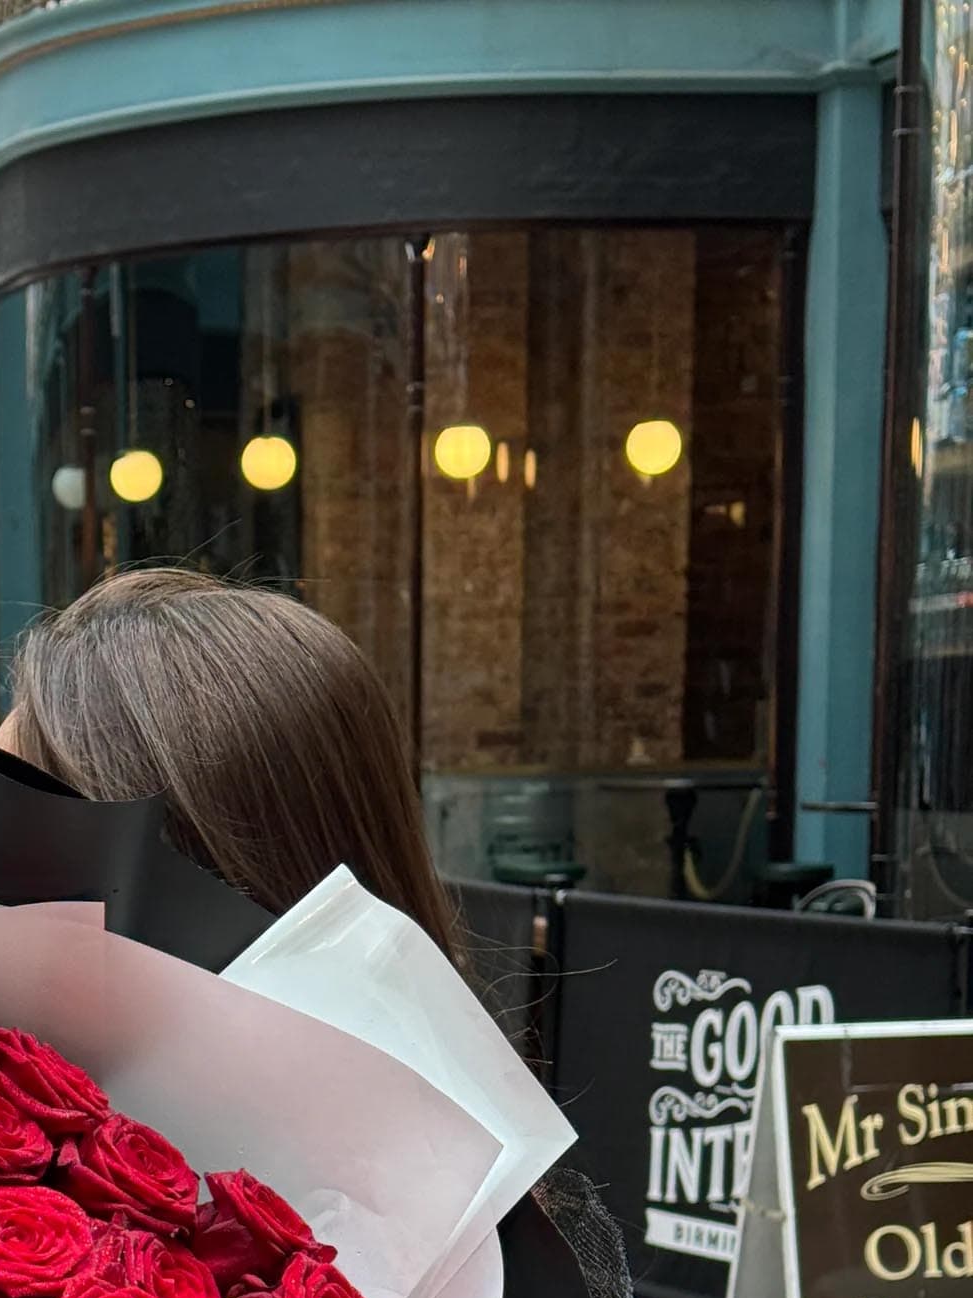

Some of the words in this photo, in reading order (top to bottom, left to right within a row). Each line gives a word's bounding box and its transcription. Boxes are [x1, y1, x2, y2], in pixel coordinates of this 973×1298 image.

[652, 1031, 688, 1061] THE
[802, 1095, 884, 1190] Mr
[864, 1222, 973, 1281] Old
